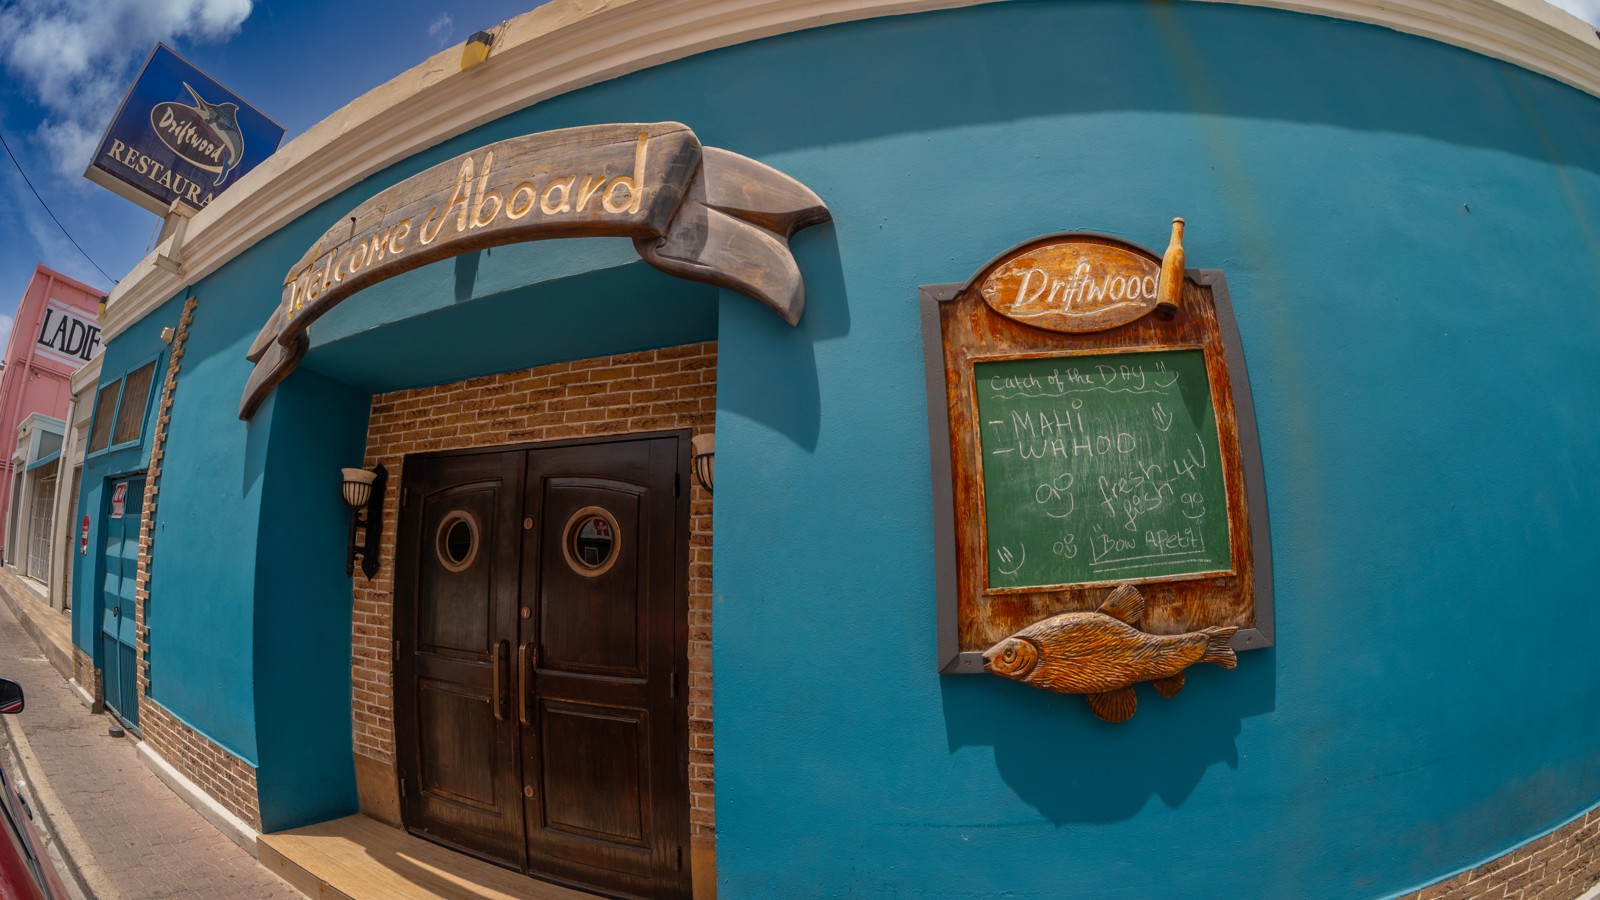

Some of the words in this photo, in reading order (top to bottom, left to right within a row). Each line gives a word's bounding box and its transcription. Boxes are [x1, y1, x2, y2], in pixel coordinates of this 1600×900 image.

[159, 106, 226, 163] Driftwood
[420, 132, 649, 245] Aboard
[1010, 257, 1161, 312] Driftwood
[1048, 369, 1065, 393] of
[1065, 367, 1094, 384] the
